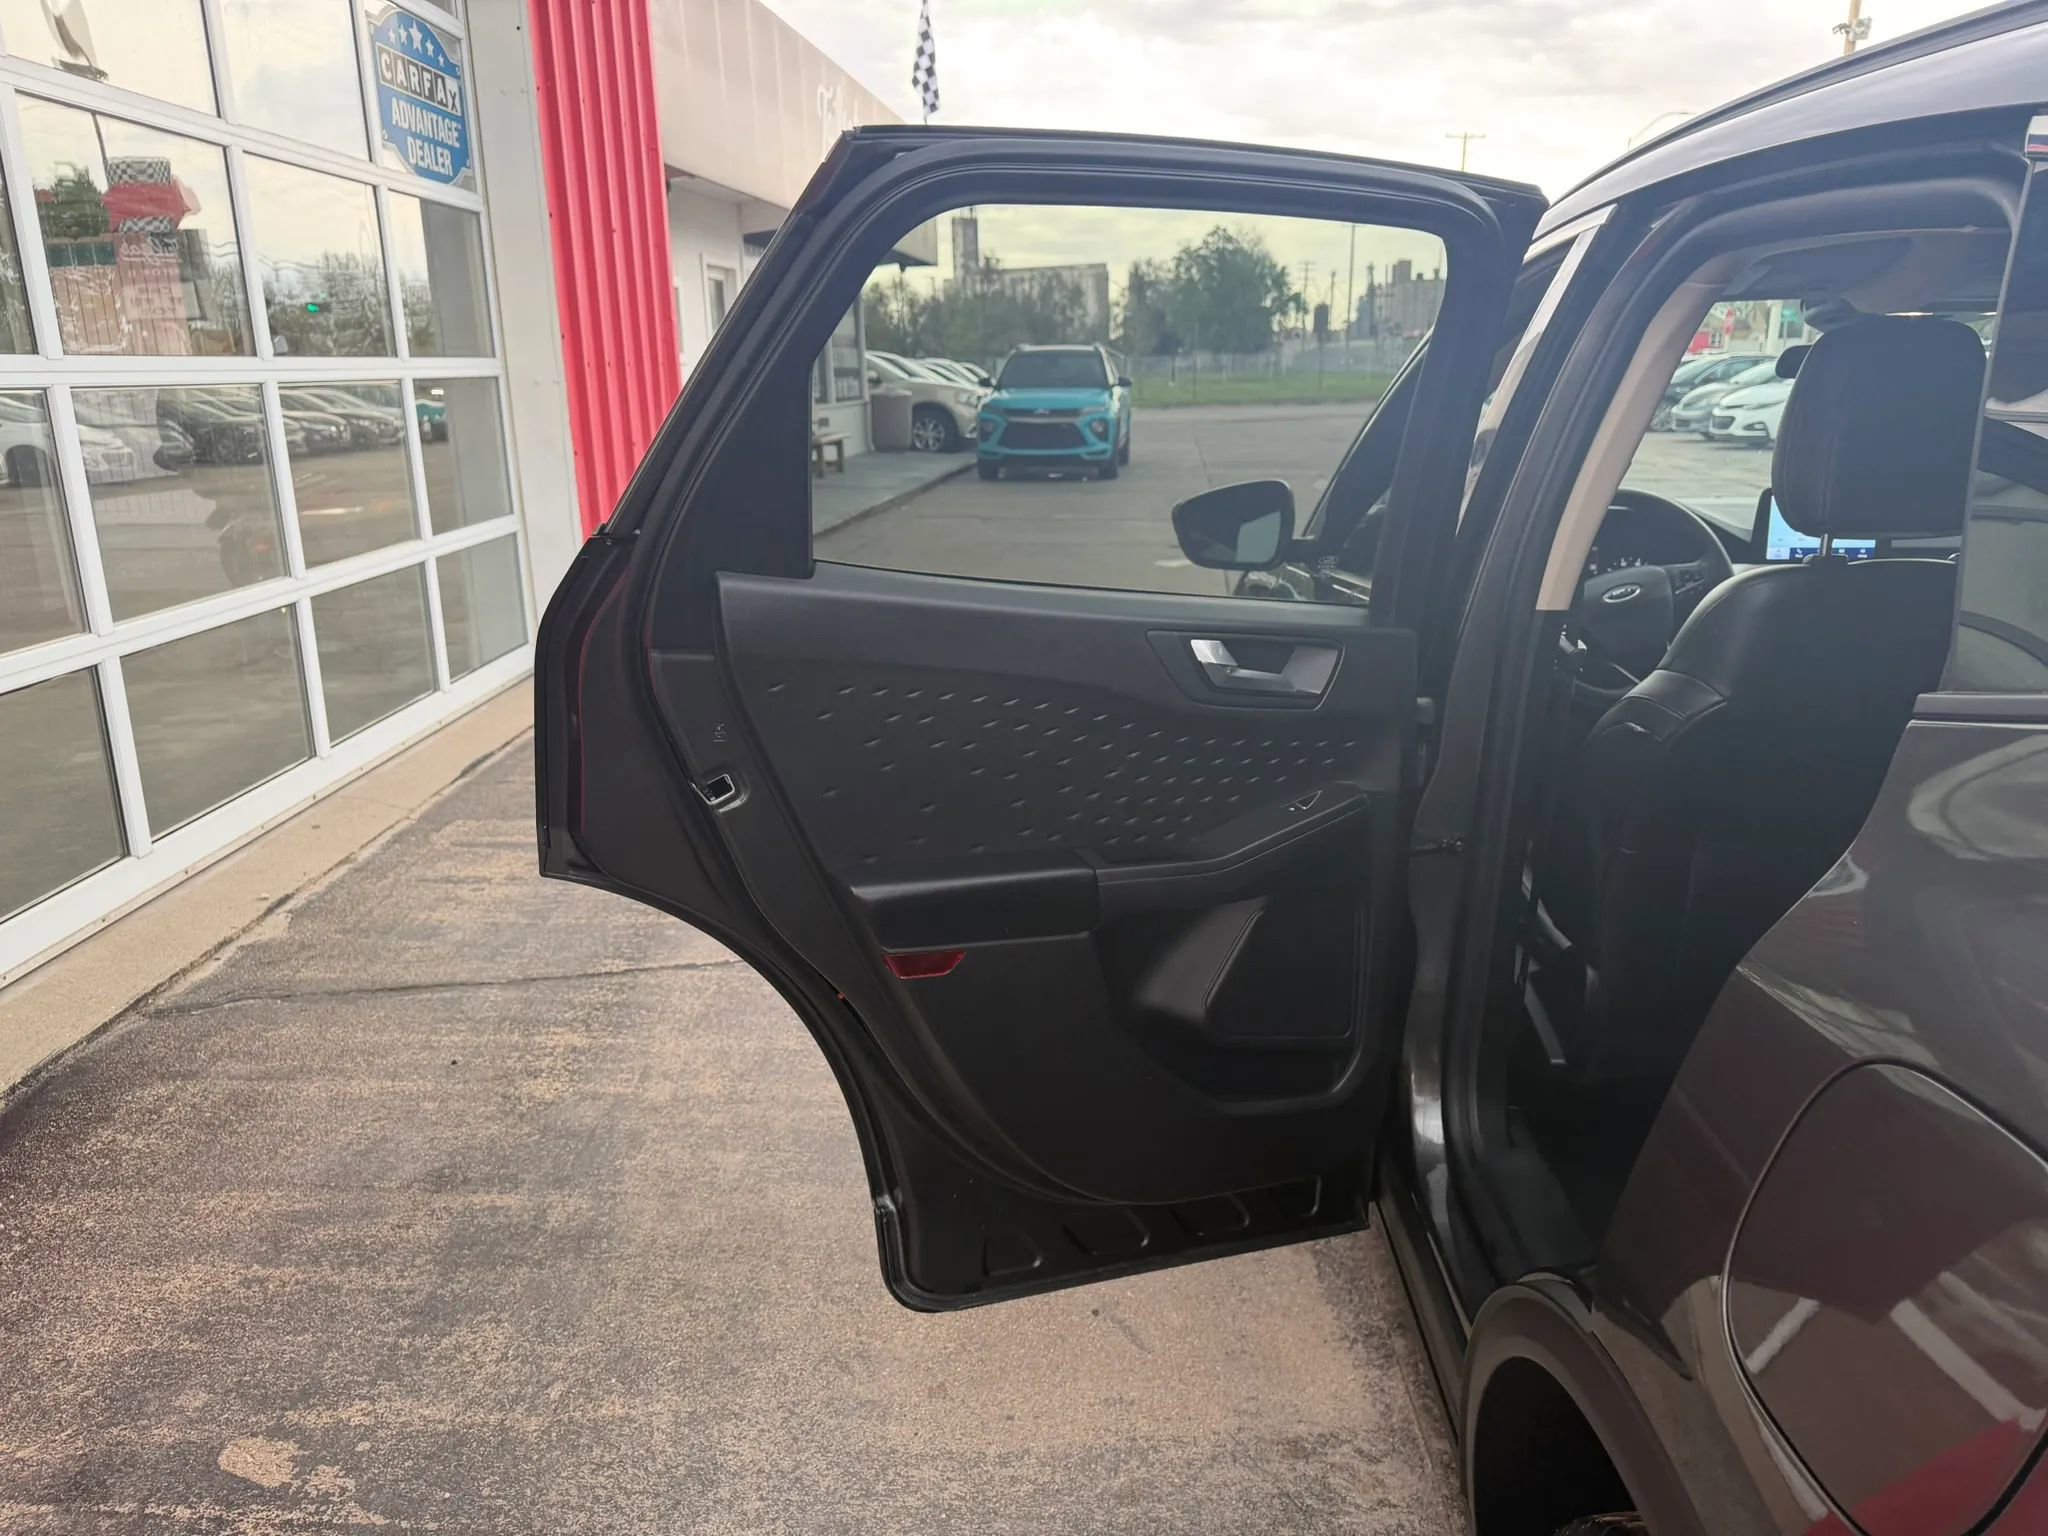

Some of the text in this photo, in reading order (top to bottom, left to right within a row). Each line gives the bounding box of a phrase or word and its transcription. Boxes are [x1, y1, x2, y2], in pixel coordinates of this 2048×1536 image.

[381, 55, 459, 113] CARFAX
[392, 97, 460, 148] ADVANTAGE
[407, 136, 453, 176] DEALER
